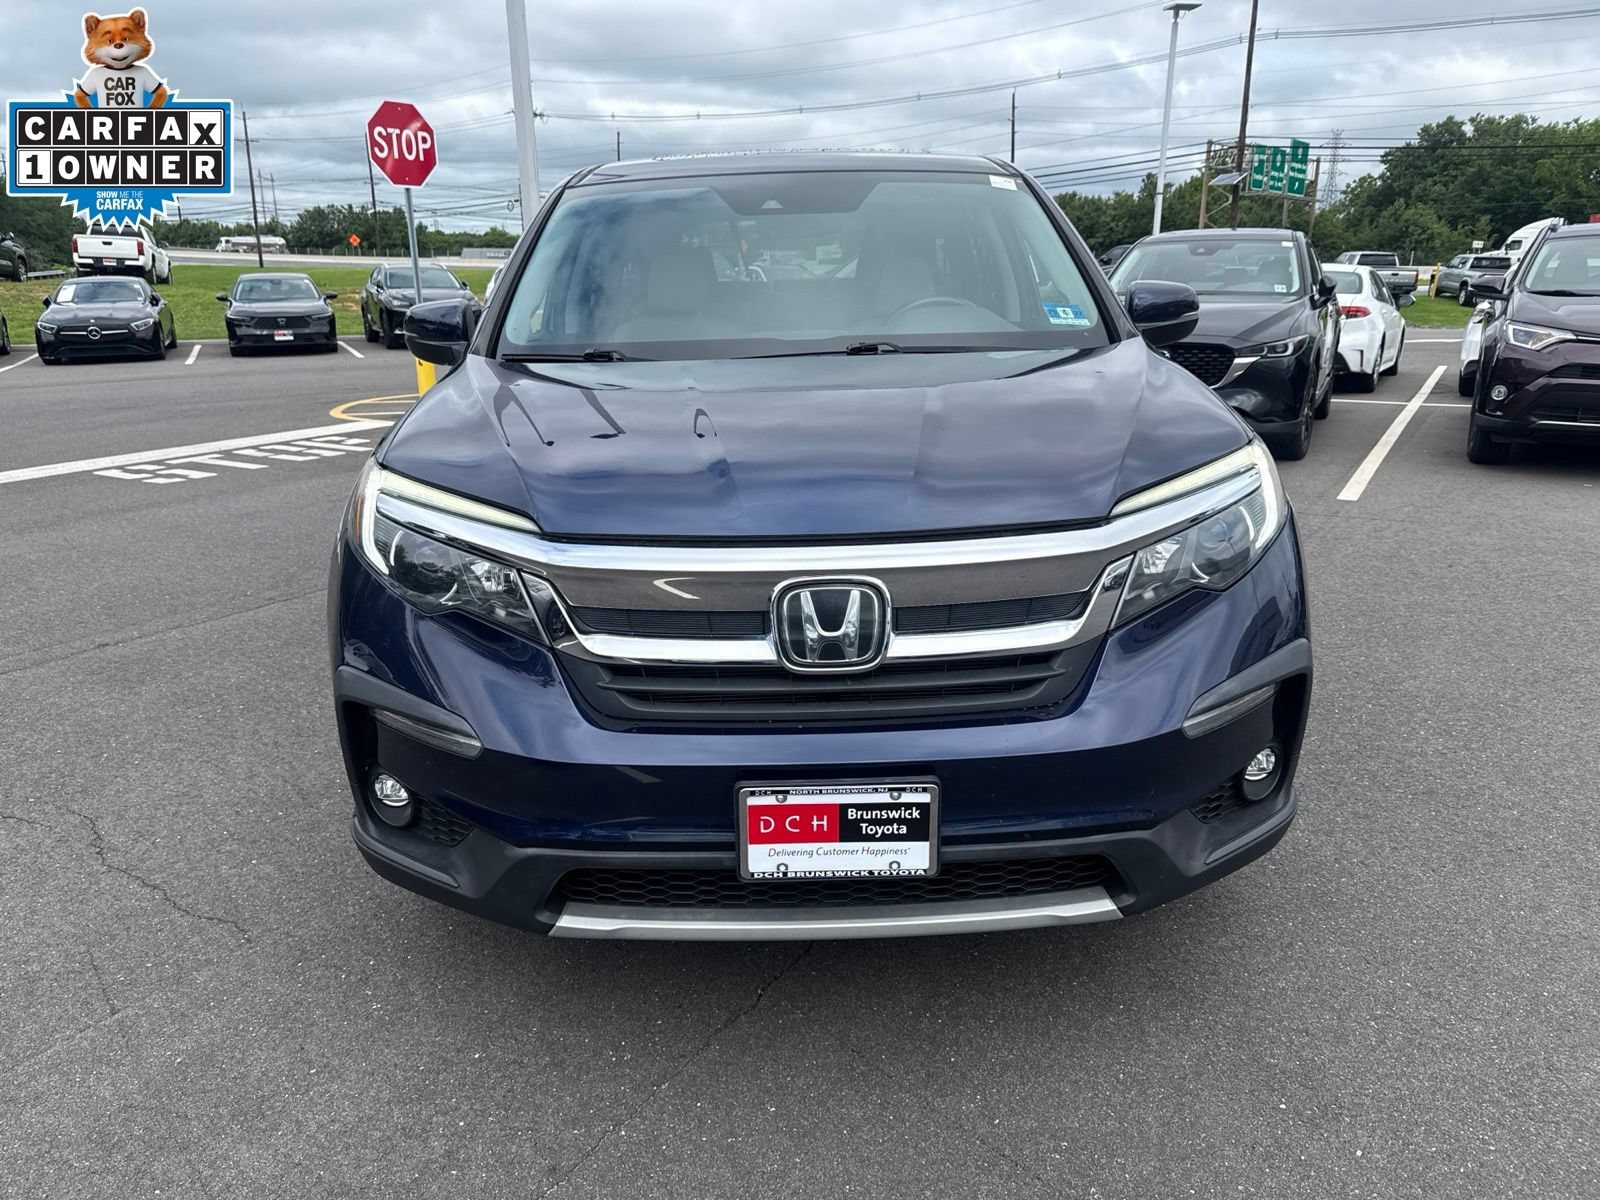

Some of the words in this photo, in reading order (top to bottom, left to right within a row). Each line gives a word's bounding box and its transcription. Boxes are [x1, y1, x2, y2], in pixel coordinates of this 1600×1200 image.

[373, 126, 431, 161] STOP
[93, 436, 374, 484] STOP
[789, 788, 820, 796] NORTH
[821, 786, 876, 795] BRUNSWICK,
[847, 806, 921, 819] Brunswick
[760, 814, 828, 833] DCH
[860, 822, 908, 838] Toyota
[768, 847, 814, 859] Delivering
[815, 846, 860, 857] Customer
[861, 846, 909, 857] Happiness
[787, 869, 870, 878] BRUNSWICK
[872, 868, 926, 877] TOYOTA
